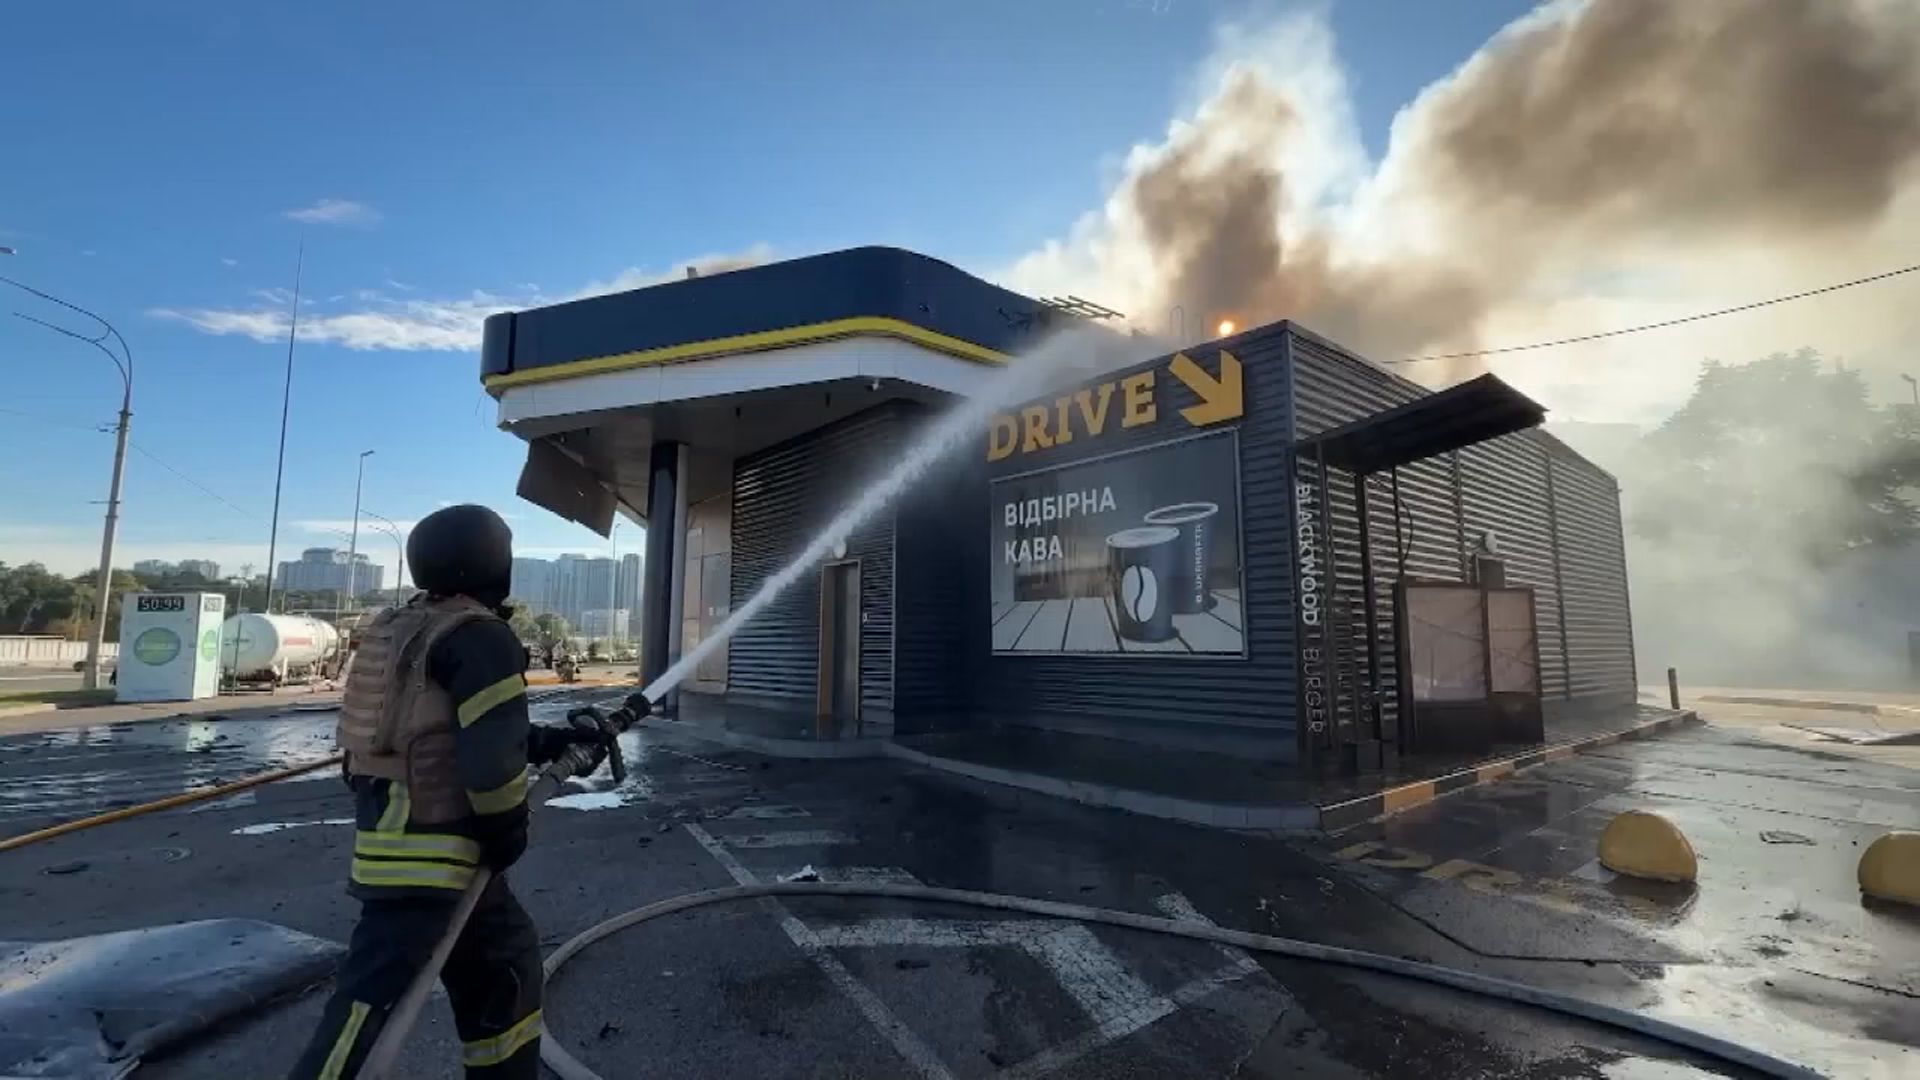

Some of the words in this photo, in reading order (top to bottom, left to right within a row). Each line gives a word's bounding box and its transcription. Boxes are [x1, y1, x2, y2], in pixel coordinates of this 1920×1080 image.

[986, 371, 1157, 462] DRIVE
[1004, 486, 1117, 528] ВІДБІРНА
[1004, 535, 1063, 564] КАВА
[1296, 486, 1320, 625] BLACKWOOD
[1303, 648, 1324, 733] BURGER
